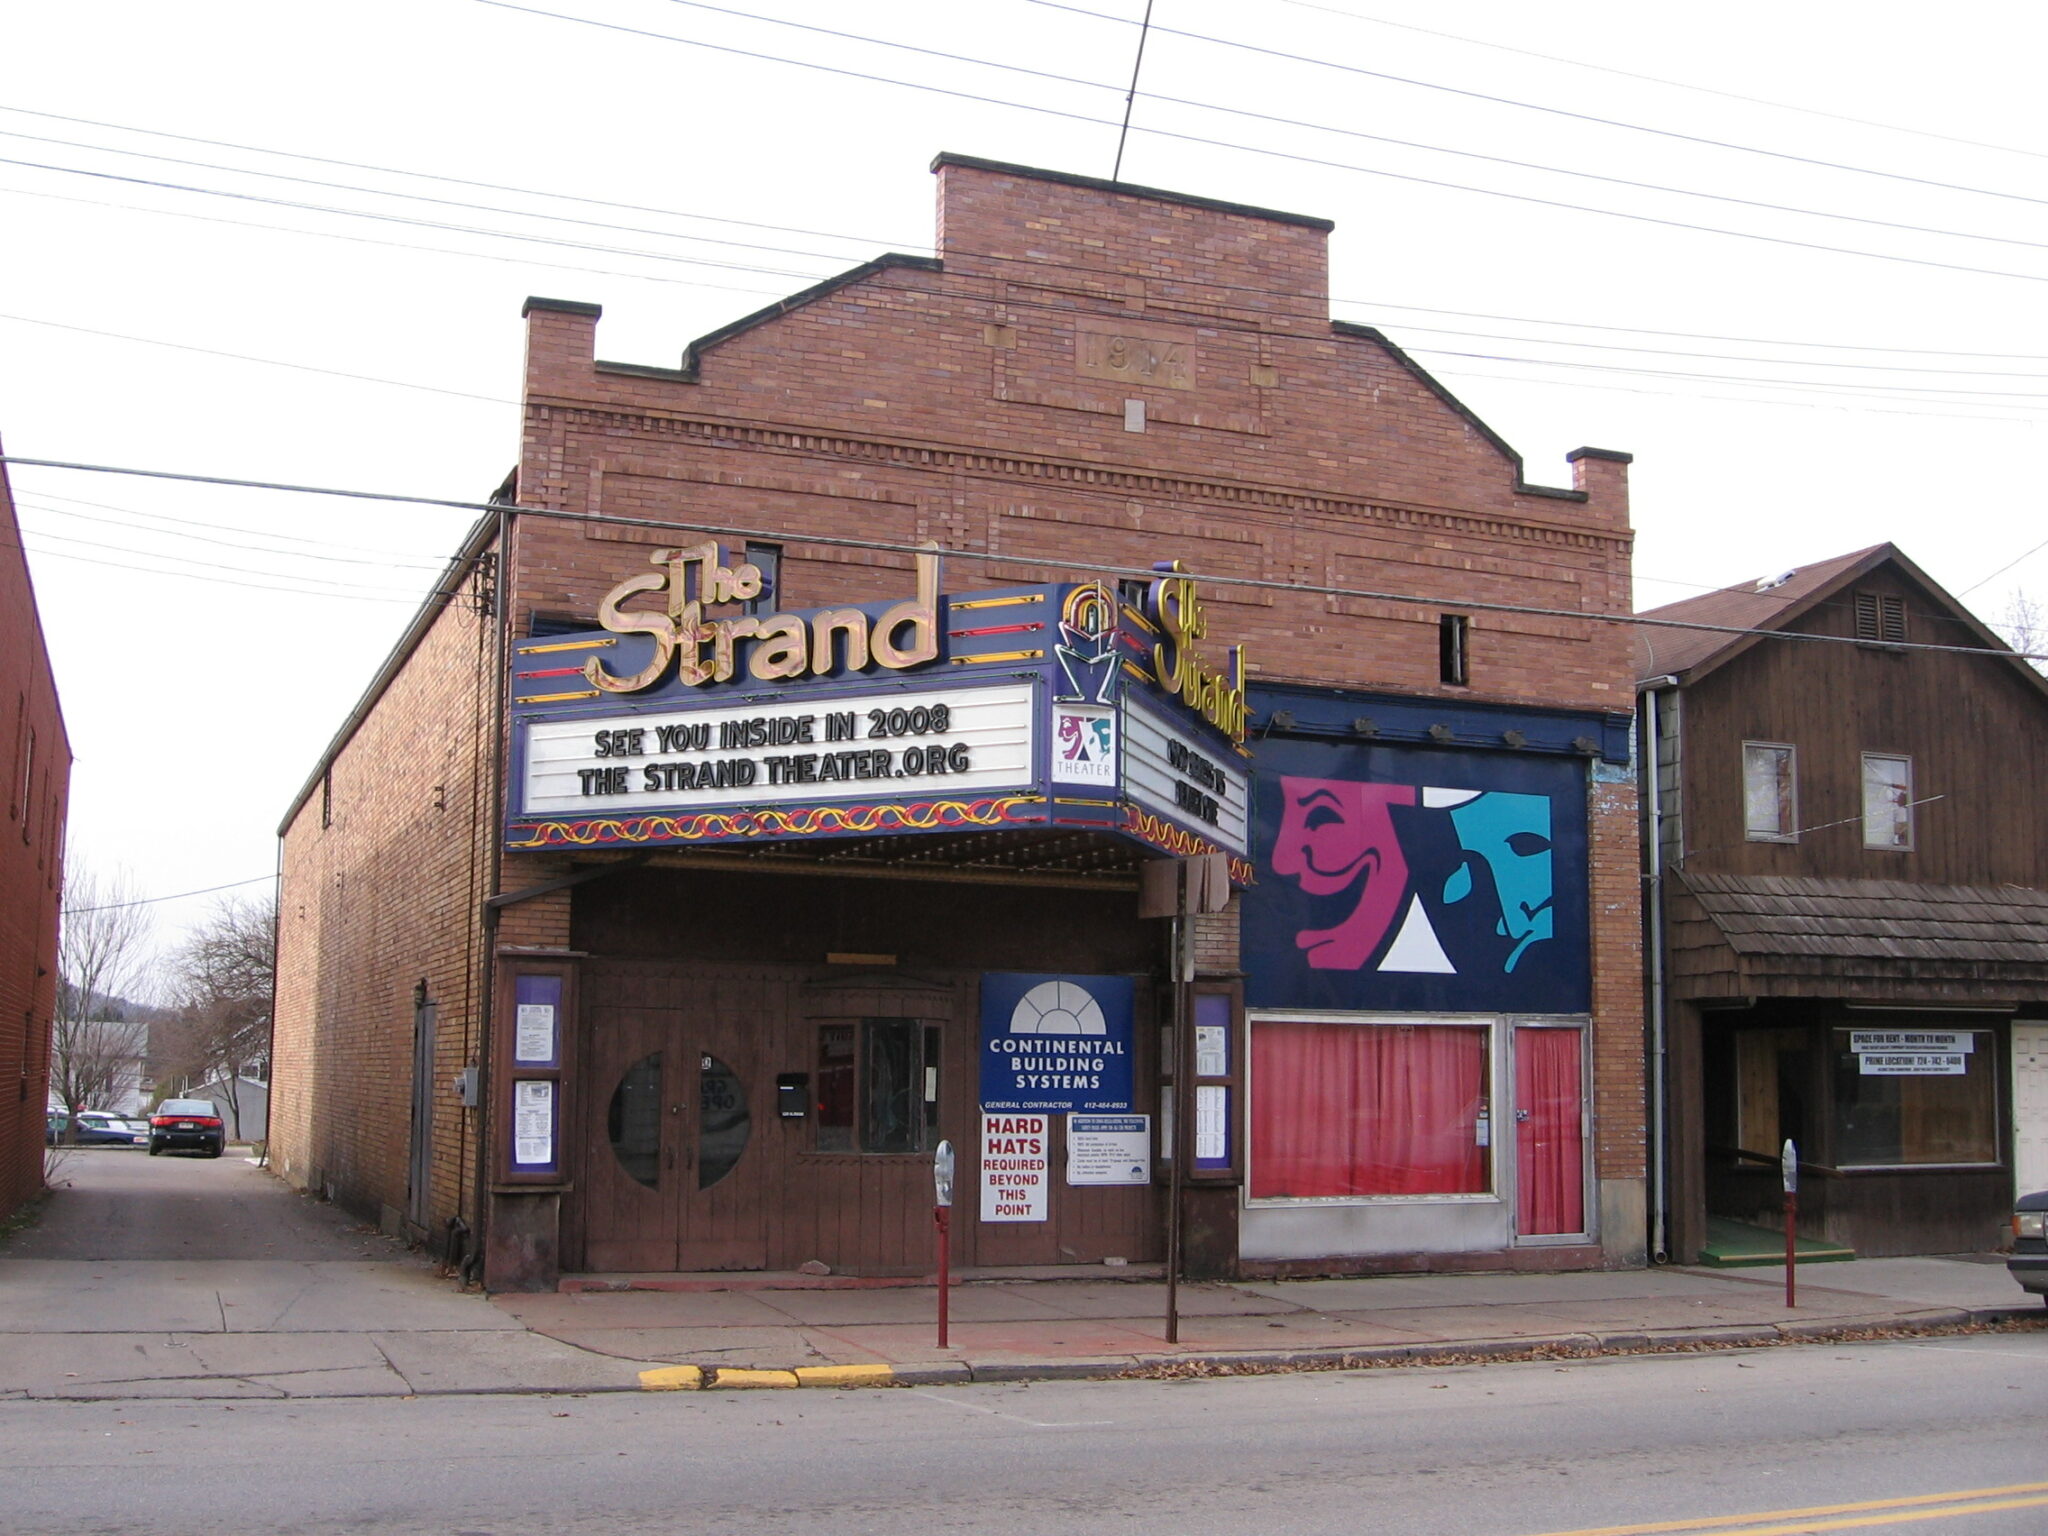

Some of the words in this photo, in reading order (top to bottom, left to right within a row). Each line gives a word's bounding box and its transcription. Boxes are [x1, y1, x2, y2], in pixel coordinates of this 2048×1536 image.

[1085, 333, 1187, 380] 1914
[650, 540, 762, 617] The
[584, 540, 938, 693] Strand
[594, 729, 645, 758] SEE
[656, 723, 710, 753] YOU
[720, 715, 814, 750] INSIDE
[825, 711, 855, 740] IN
[867, 703, 950, 738] 2008
[1058, 761, 1112, 776] THEATER
[577, 766, 629, 796] THE
[643, 758, 756, 791] STRAND
[1873, 1034, 1884, 1043] FOR
[1886, 1034, 1900, 1043] RENT
[989, 1038, 1125, 1055] CONTINENTAL
[1011, 1057, 1105, 1072] BUILDING
[1015, 1074, 1100, 1089] SYSTEMS
[985, 1101, 1020, 1109] GENERAL
[1022, 1101, 1073, 1109] CONTRACTOR
[986, 1117, 1043, 1135] HARD
[988, 1138, 1042, 1155] HATS
[983, 1158, 1045, 1171] REQUIRED
[989, 1173, 1039, 1186] BEYOND
[998, 1188, 1026, 1201] THIS
[995, 1203, 1032, 1216] POINT
